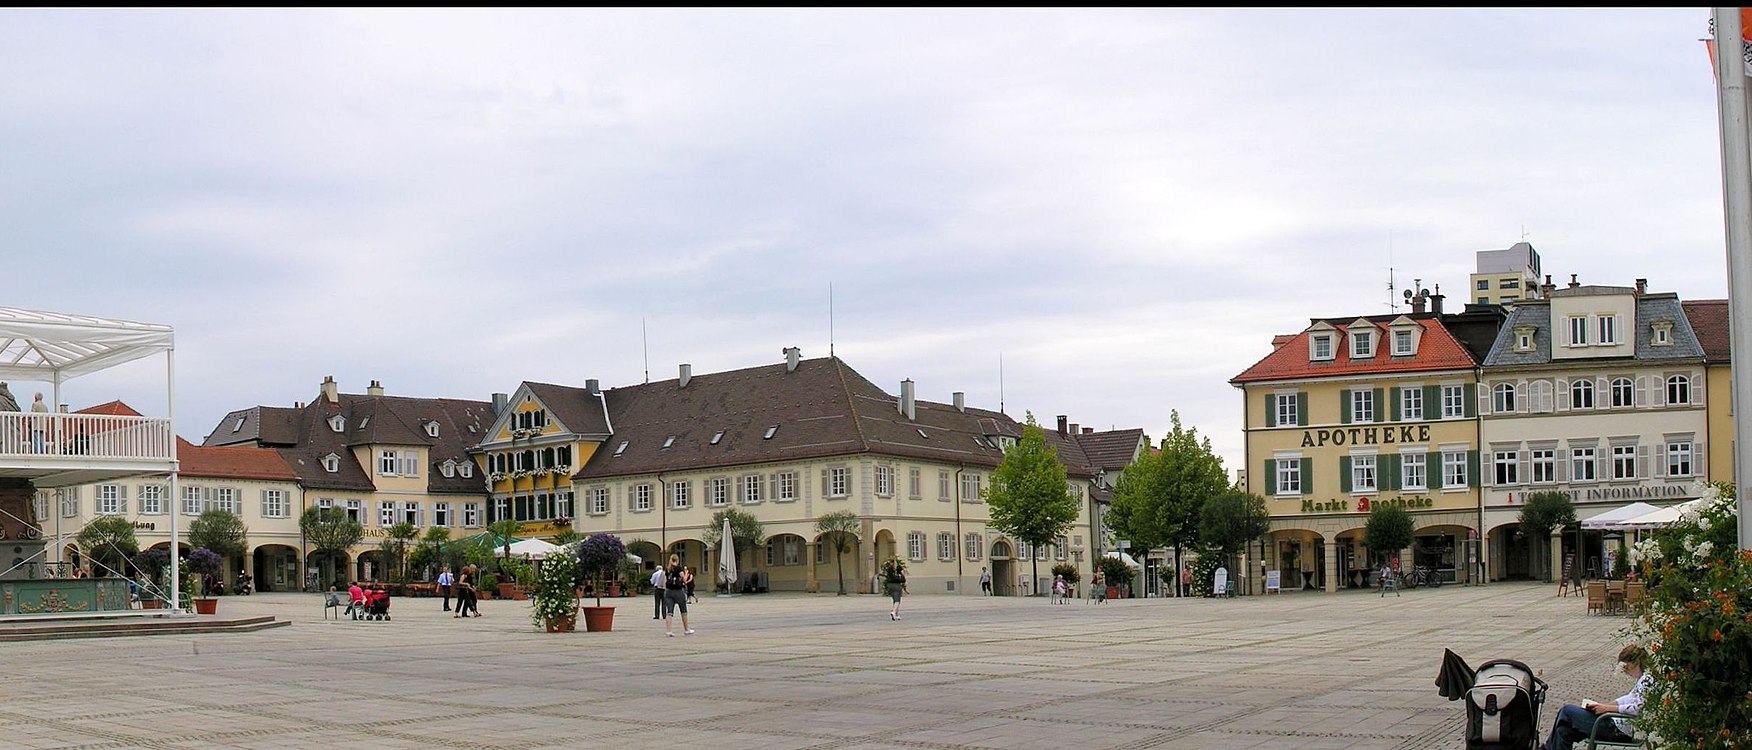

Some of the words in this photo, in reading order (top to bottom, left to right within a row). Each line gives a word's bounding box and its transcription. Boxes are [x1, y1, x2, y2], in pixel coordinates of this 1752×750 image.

[1301, 425, 1431, 447] APOTHEKE
[1518, 490, 1580, 502] TOST
[1587, 485, 1688, 500] INFORMATION
[1301, 499, 1348, 512] Markt
[1357, 496, 1433, 512] Apotheke
